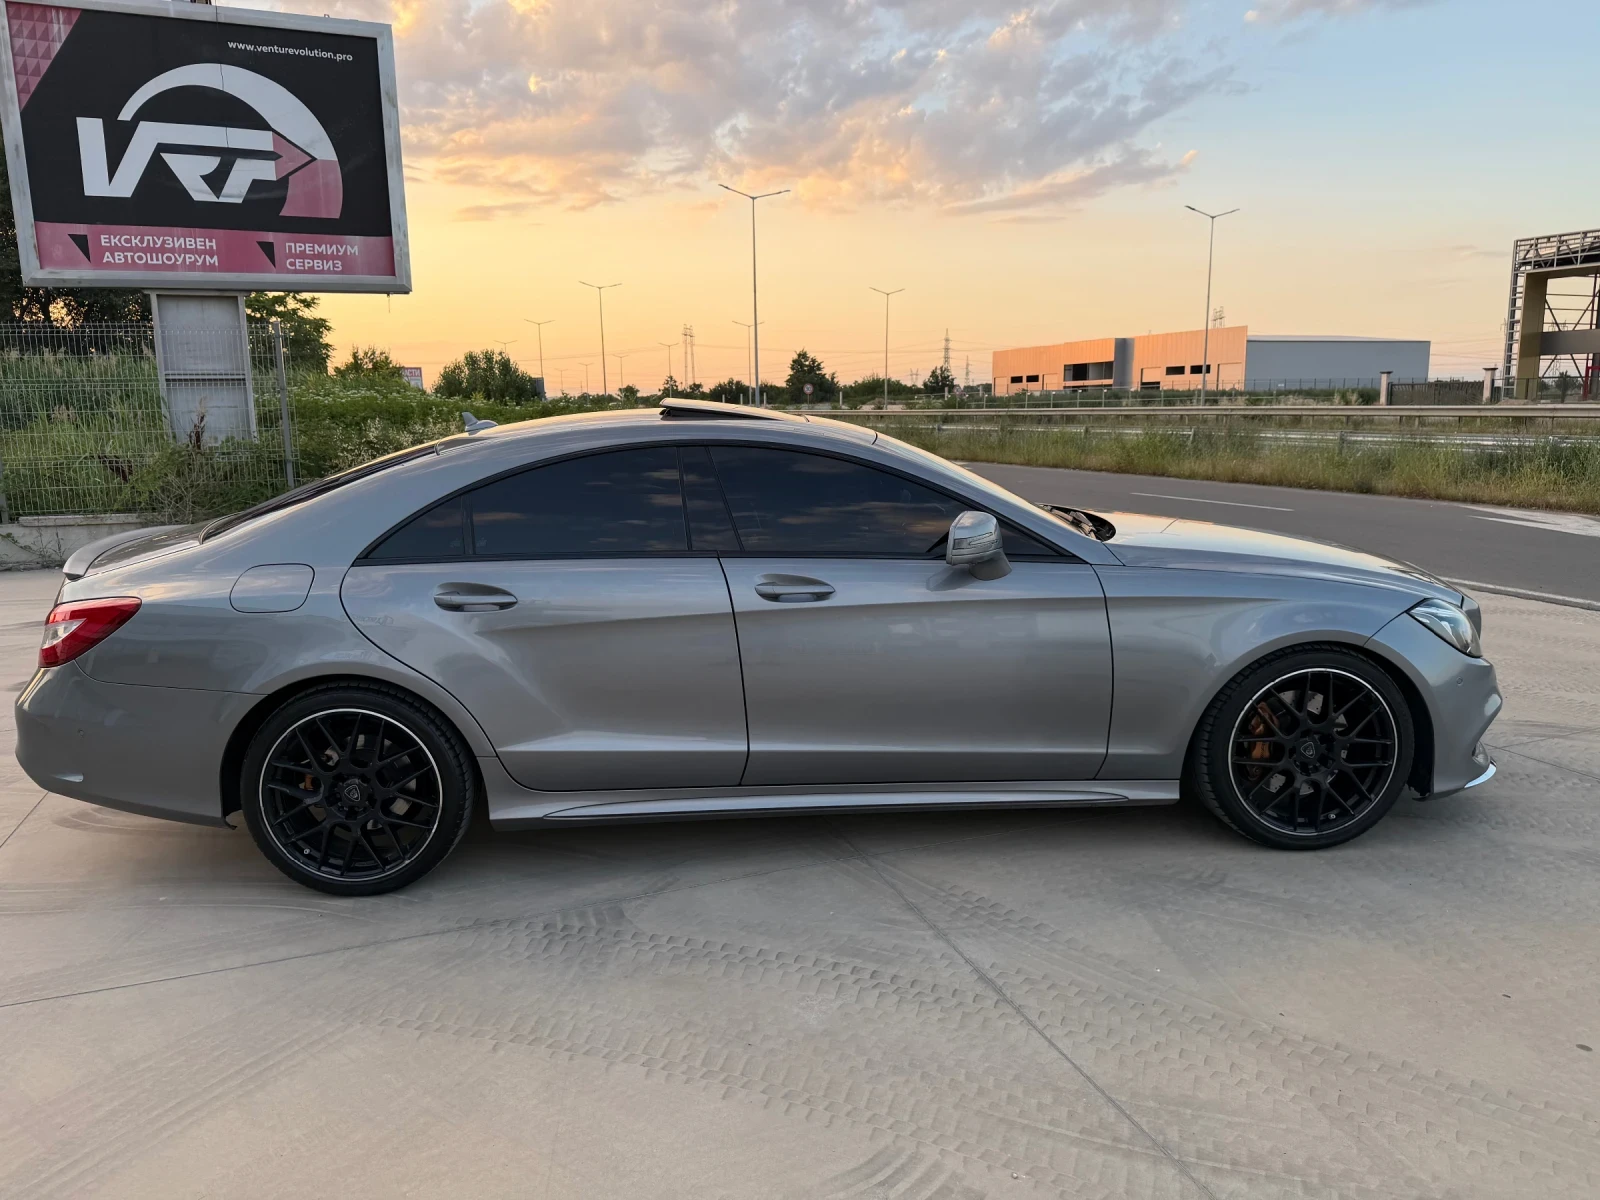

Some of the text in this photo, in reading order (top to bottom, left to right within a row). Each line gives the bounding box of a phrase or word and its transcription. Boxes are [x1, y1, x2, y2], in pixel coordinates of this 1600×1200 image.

[227, 40, 353, 62] www.venturevolution.pro
[100, 234, 217, 250] ЕКСКЛУЗИВЕН
[285, 242, 359, 256] ПРЕМИУМ
[102, 251, 219, 267] АВТОШОУРУМ
[286, 258, 343, 271] СЕРВИЗ
